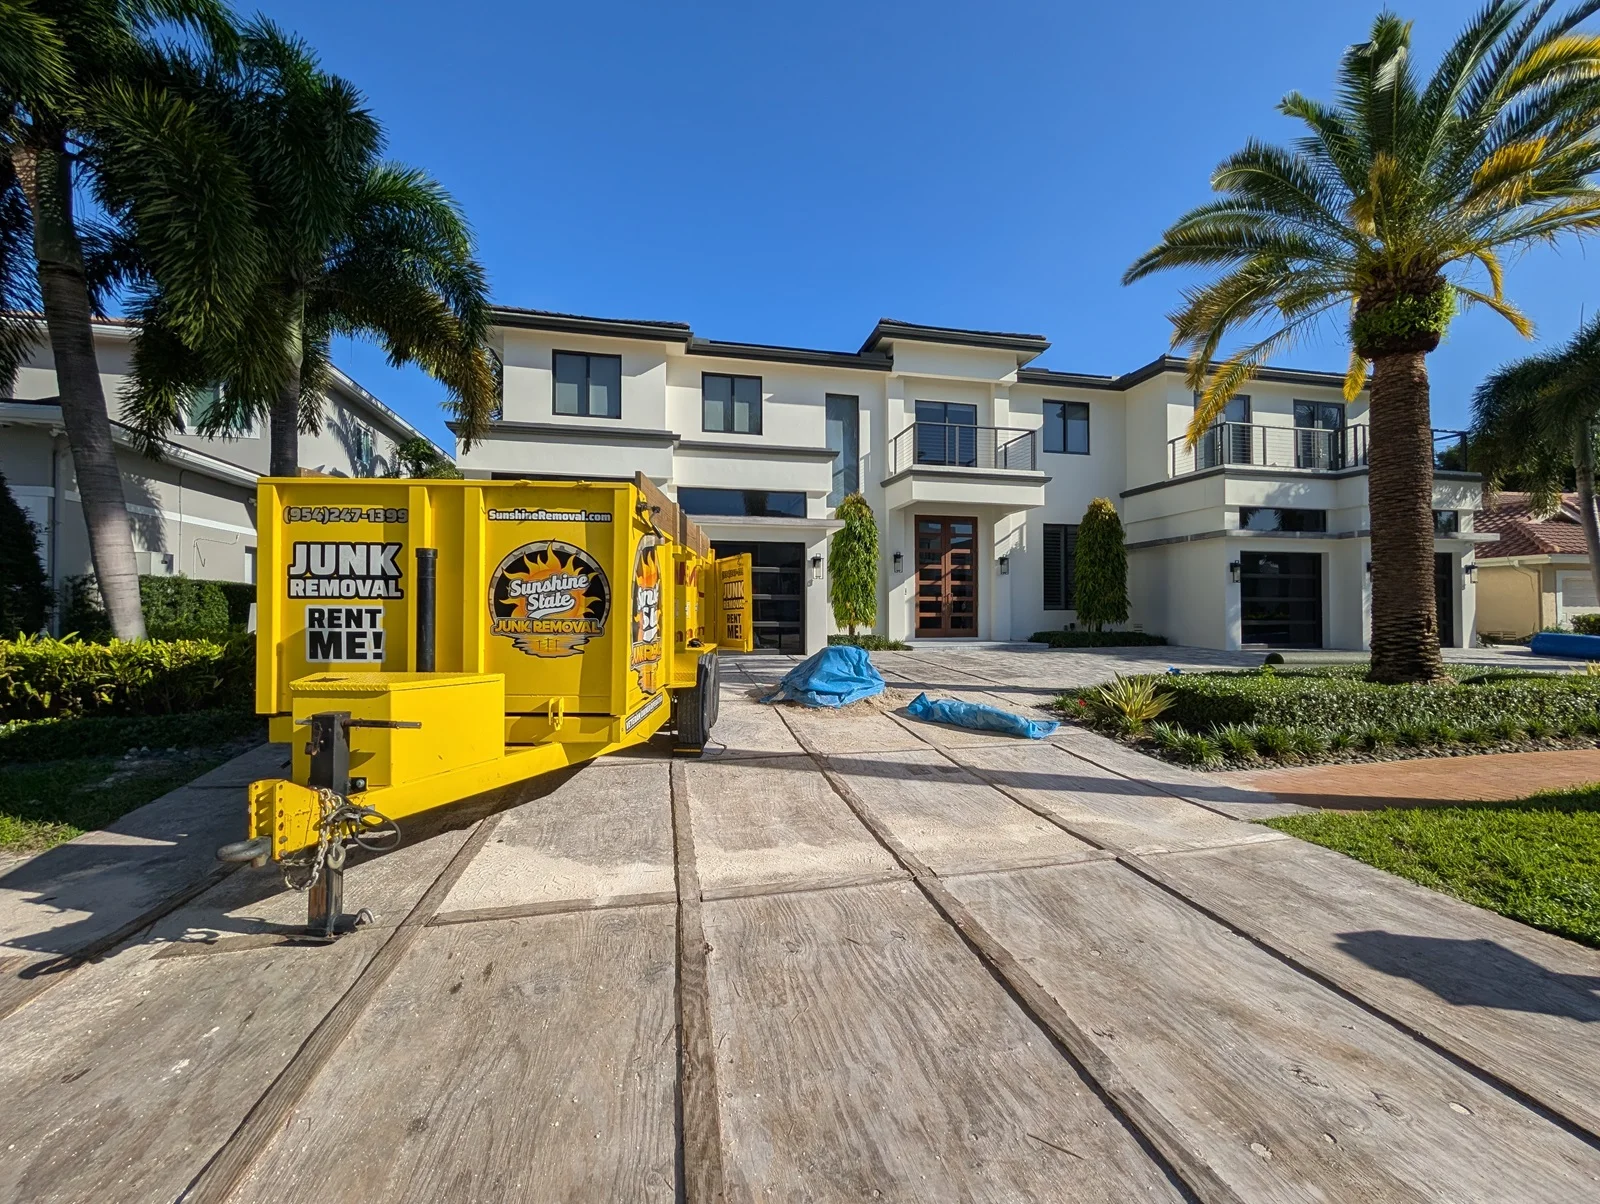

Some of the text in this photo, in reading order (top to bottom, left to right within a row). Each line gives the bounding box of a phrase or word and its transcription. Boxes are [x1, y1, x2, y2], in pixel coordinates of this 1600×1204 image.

[283, 506, 409, 524] (954)247-1399
[488, 508, 612, 522] SunshineRemoval.com
[288, 542, 402, 577] JUNK
[288, 578, 402, 598] REMOVAL
[509, 573, 589, 597] Sunshine
[723, 580, 744, 599] JUNK
[527, 592, 576, 612] State
[308, 607, 382, 629] RENT
[494, 620, 601, 634] JUNK REMOVAL
[726, 613, 741, 624] RENT
[727, 625, 742, 639] ME!
[308, 631, 383, 660] ME!
